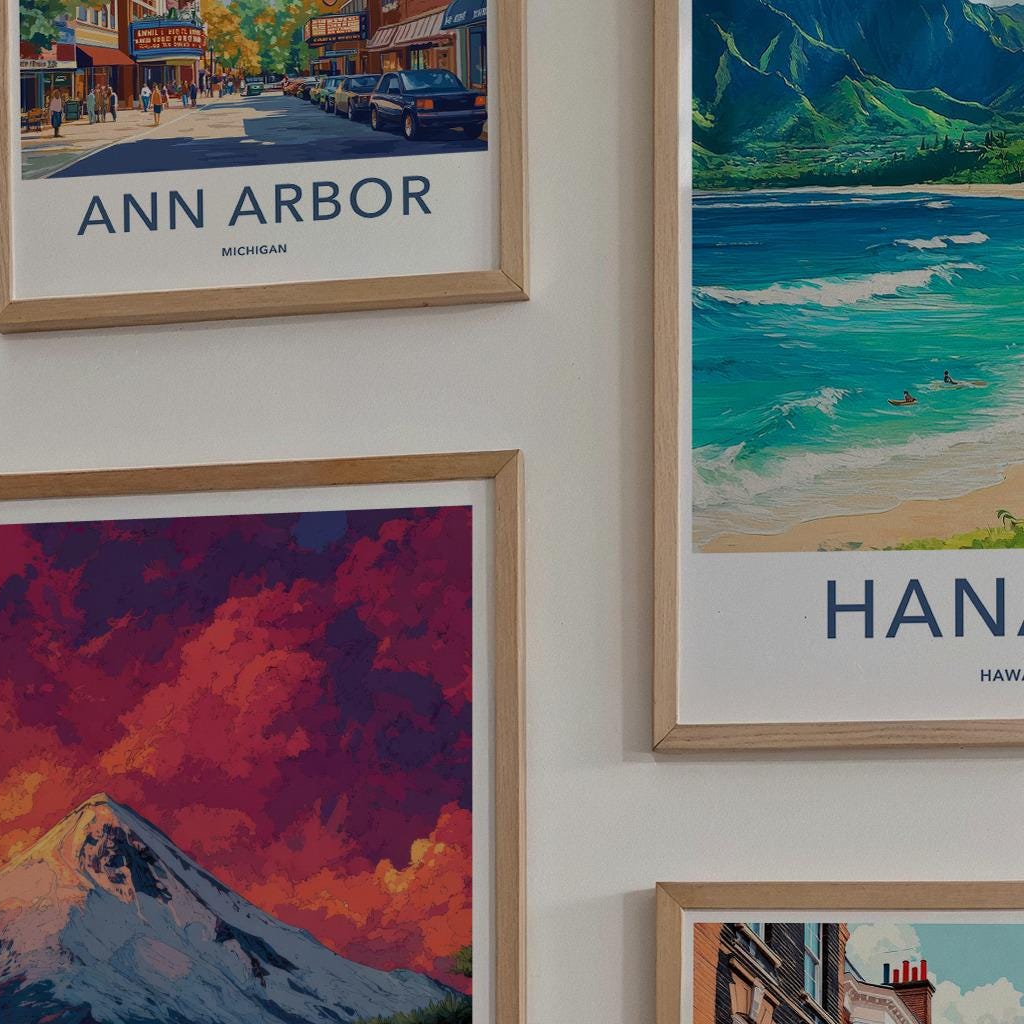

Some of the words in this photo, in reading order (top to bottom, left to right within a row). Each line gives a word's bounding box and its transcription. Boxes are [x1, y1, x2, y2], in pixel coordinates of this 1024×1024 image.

[76, 188, 205, 236] ANN
[228, 175, 432, 227] ARBOR
[221, 243, 288, 257] MICHIGAN
[826, 577, 1024, 640] HAN
[980, 668, 1024, 682] HAW
